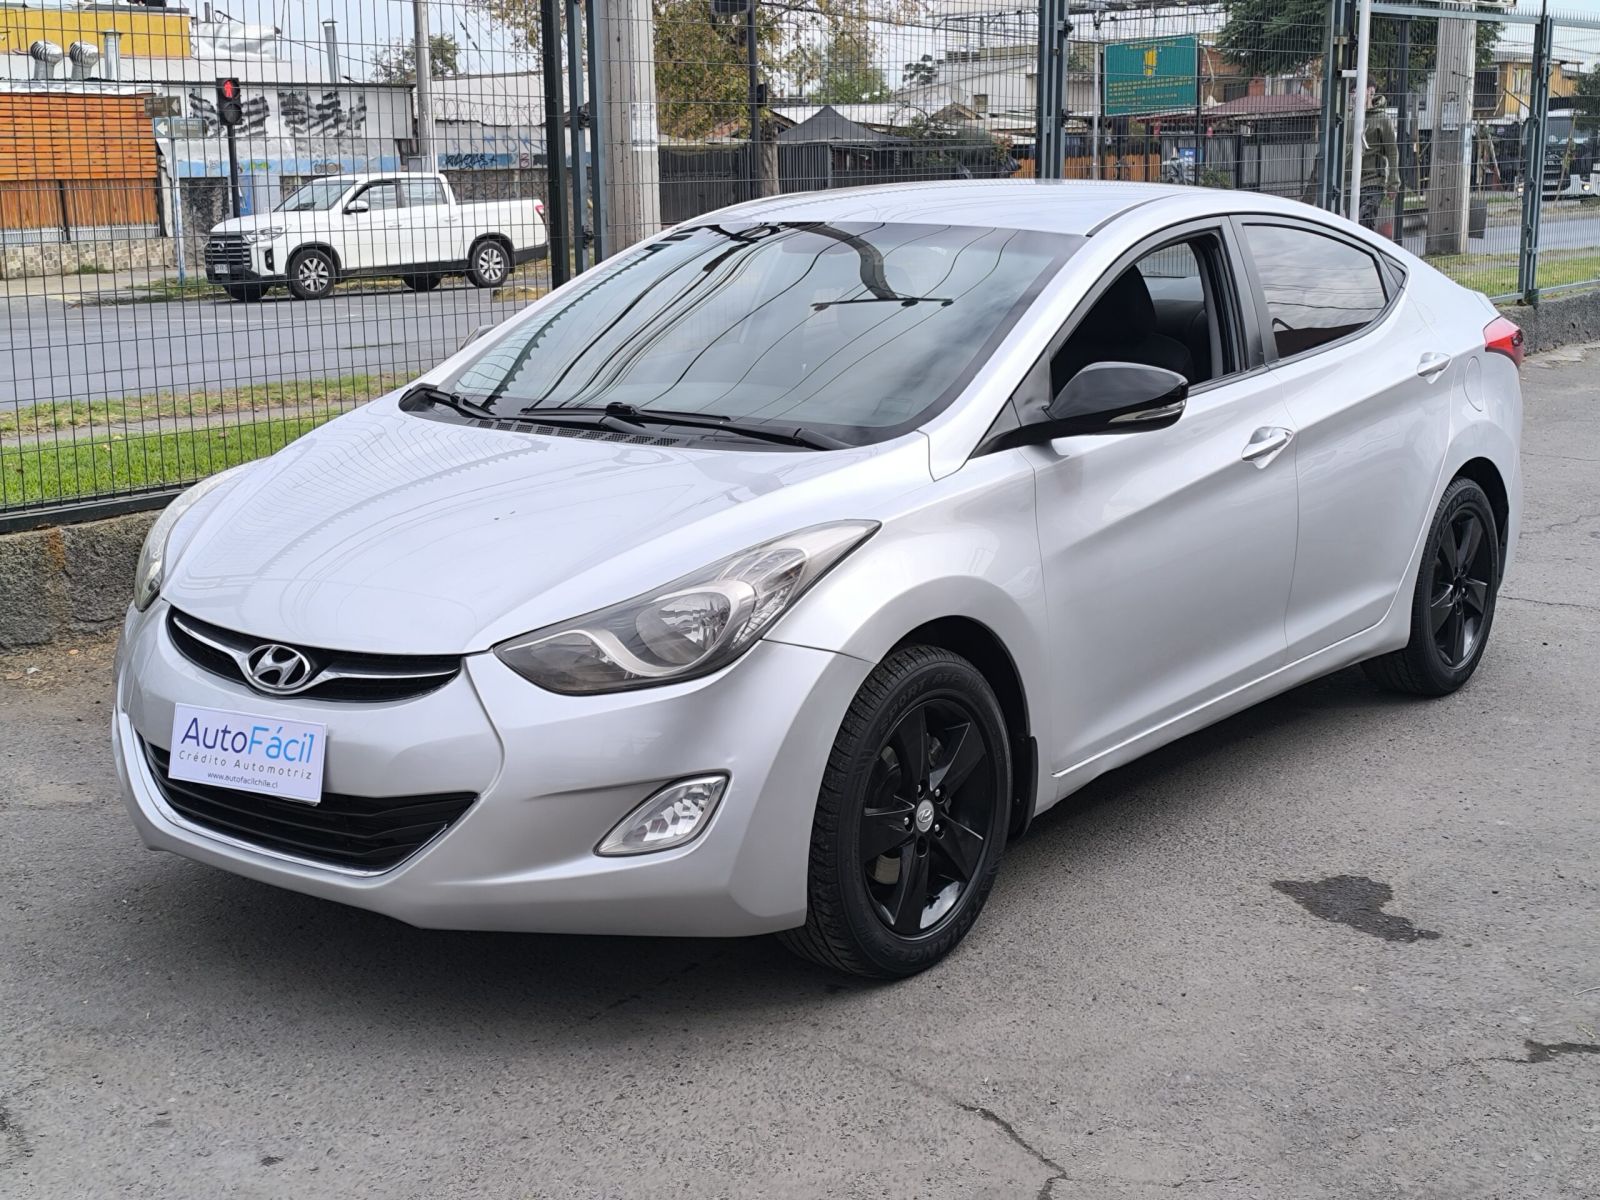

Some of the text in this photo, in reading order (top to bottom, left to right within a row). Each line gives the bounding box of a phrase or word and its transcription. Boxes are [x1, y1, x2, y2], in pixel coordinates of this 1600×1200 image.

[181, 717, 315, 763] AutoFácil
[179, 750, 312, 780] Crédito Automotriz
[207, 772, 278, 789] www.autofacilchile.cl
